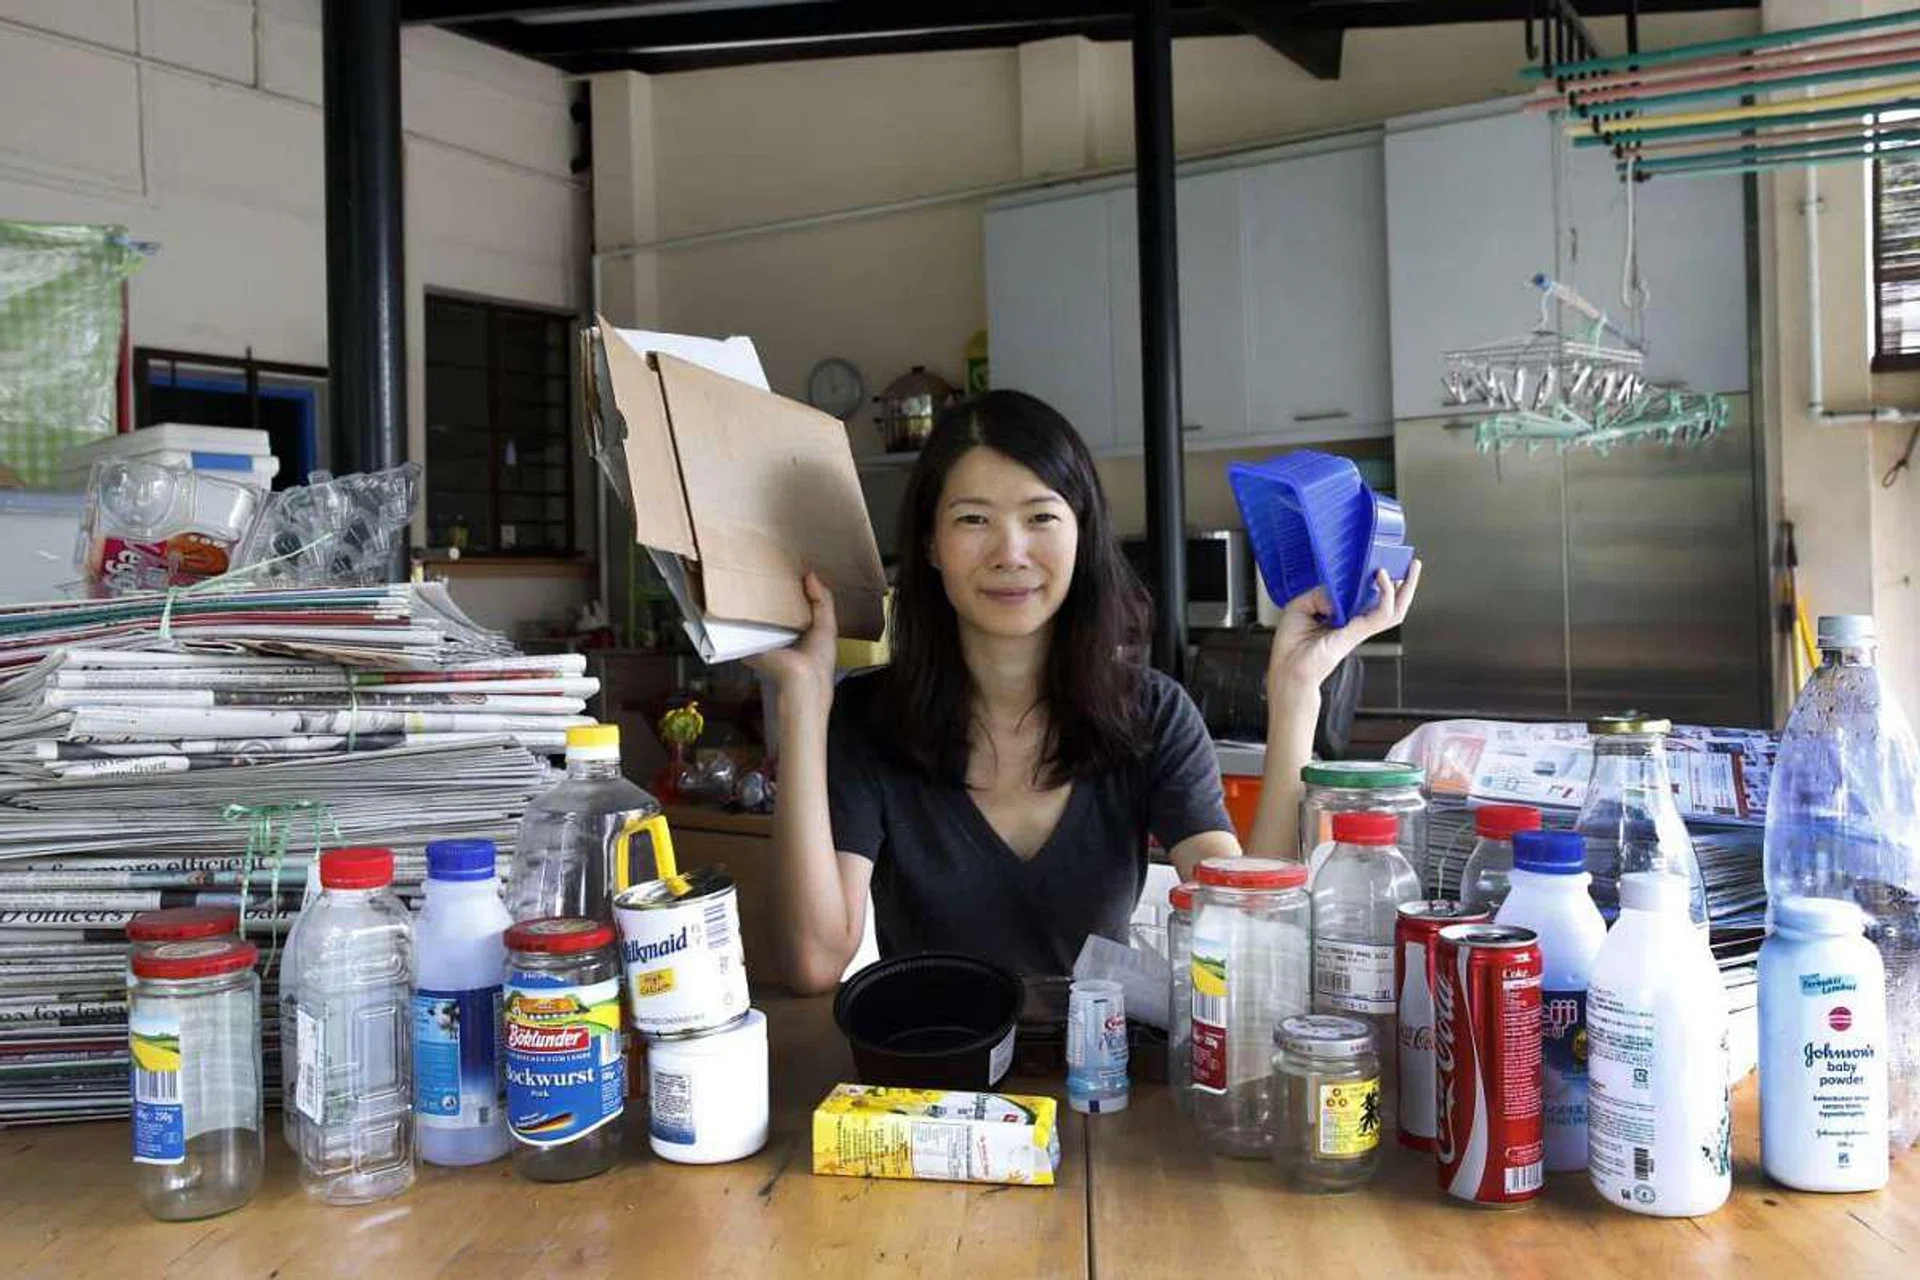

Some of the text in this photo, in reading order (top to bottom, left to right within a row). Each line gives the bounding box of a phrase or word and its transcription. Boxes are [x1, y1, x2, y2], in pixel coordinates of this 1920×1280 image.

[508, 1024, 581, 1048] Böklunder
[1827, 1060, 1858, 1074] baby
[1819, 1072, 1864, 1087] powder
